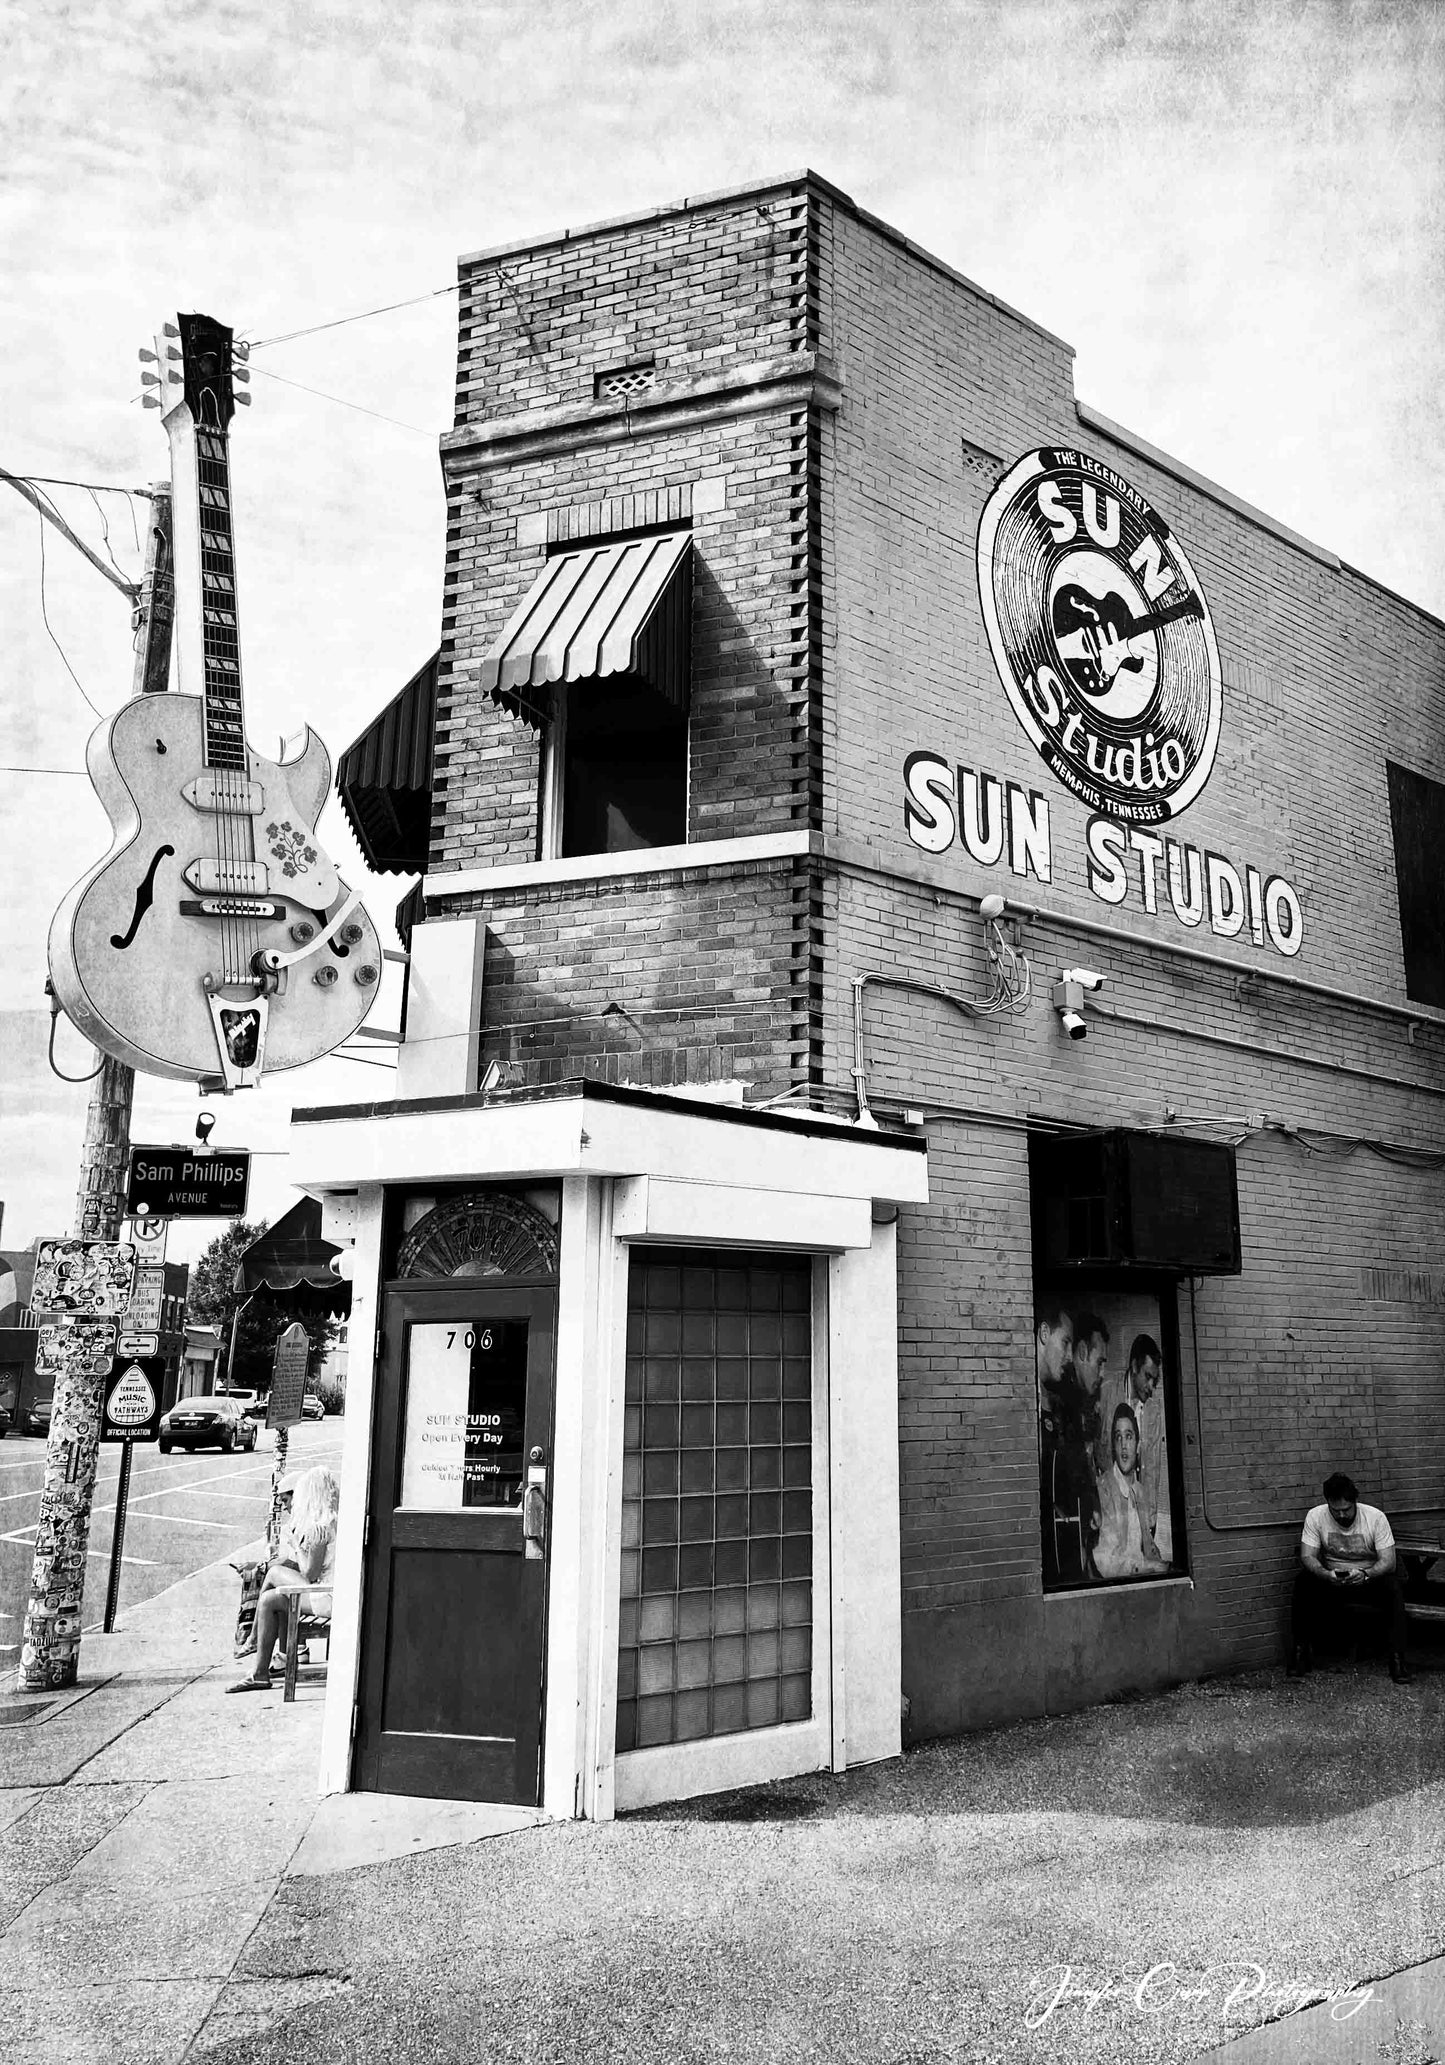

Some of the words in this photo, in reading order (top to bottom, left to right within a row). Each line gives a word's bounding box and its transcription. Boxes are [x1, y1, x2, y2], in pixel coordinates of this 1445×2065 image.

[1053, 451, 1078, 466] THE
[1080, 454, 1151, 515] LEGENDARY
[1037, 480, 1177, 601] SUN
[1023, 665, 1185, 790] Studio
[1105, 798, 1163, 820] TENNESSEE
[903, 750, 1052, 884] SUN
[1086, 812, 1303, 957] STUDIO
[135, 1161, 174, 1181] Sam
[182, 1162, 244, 1187] Phillips
[167, 1192, 208, 1204] AVENUE
[137, 1290, 150, 1298] BUS
[132, 1320, 149, 1328] ONY
[446, 1329, 493, 1350] 706
[118, 1394, 147, 1403] MUSIC
[114, 1406, 148, 1414] PATHWAYS
[454, 1414, 501, 1426] STUDIO
[106, 1428, 127, 1436] OFFICIAL
[127, 1428, 151, 1436] LOCATION
[421, 1433, 448, 1444] Open
[450, 1433, 481, 1445] Every
[483, 1432, 503, 1445] Day
[474, 1464, 501, 1474] Hourly
[466, 1473, 485, 1481] Past
